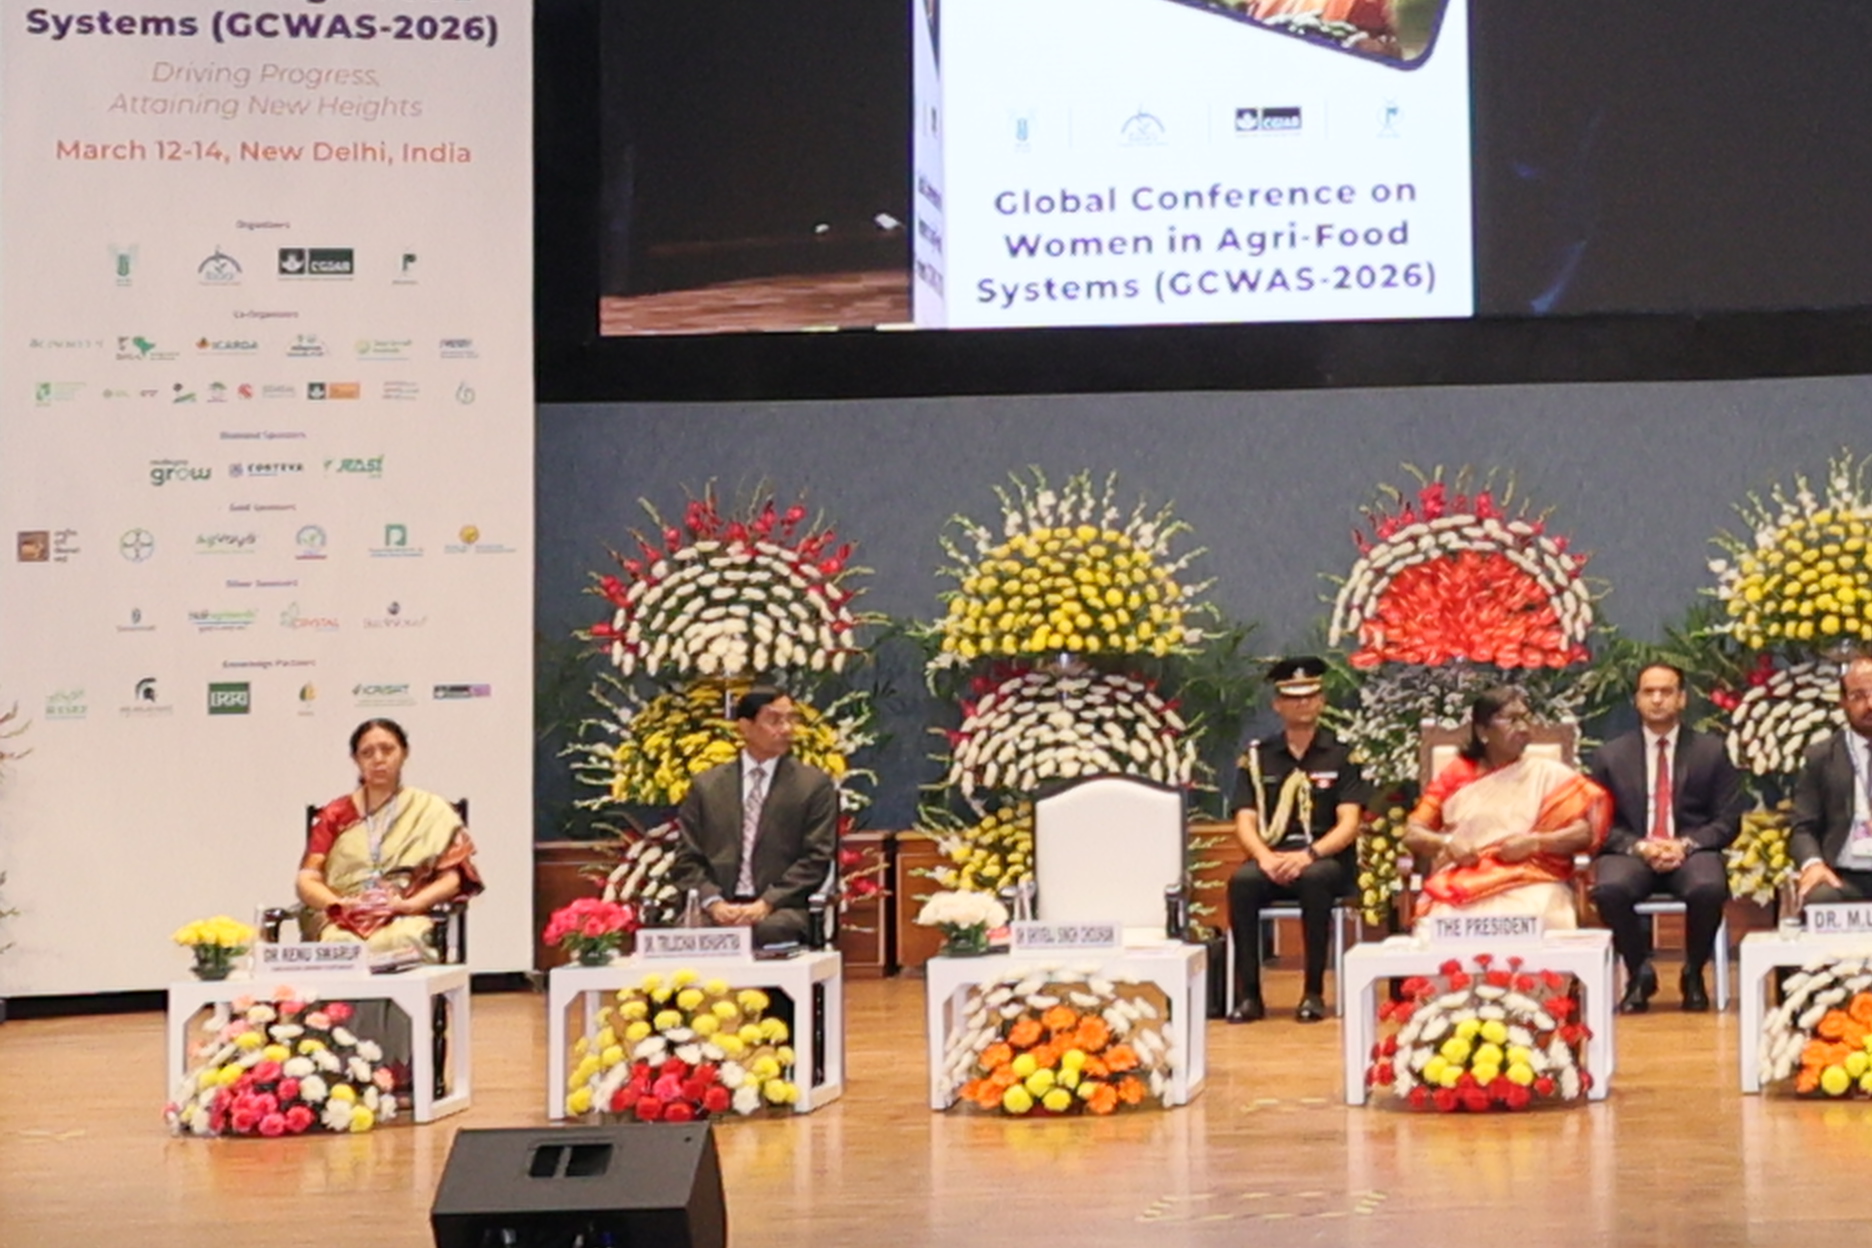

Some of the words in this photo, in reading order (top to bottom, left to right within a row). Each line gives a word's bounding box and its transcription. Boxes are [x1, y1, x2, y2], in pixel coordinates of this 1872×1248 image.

[27, 9, 198, 40] Systems
[212, 11, 497, 47] (GCWAS-2026)
[152, 61, 251, 89] Driving
[108, 92, 240, 120] Attaining
[249, 95, 310, 116] New
[317, 96, 422, 122] Heights
[57, 140, 145, 160] March
[157, 140, 230, 164] 12-14,
[241, 142, 303, 161] New
[313, 141, 393, 165] Delhi,
[403, 142, 471, 163] India
[995, 188, 1115, 215] Global
[1132, 183, 1355, 211] Conference
[1371, 183, 1416, 202] on
[1005, 235, 1152, 258] Women
[1169, 226, 1201, 252] in
[1218, 221, 1408, 256] Agri-Food
[978, 278, 1139, 309] Systems
[1155, 262, 1435, 303] (GCWAS-2026)
[1436, 918, 1460, 936] THE
[1466, 916, 1537, 936] PRESIDENT
[1815, 910, 1840, 929] DR.
